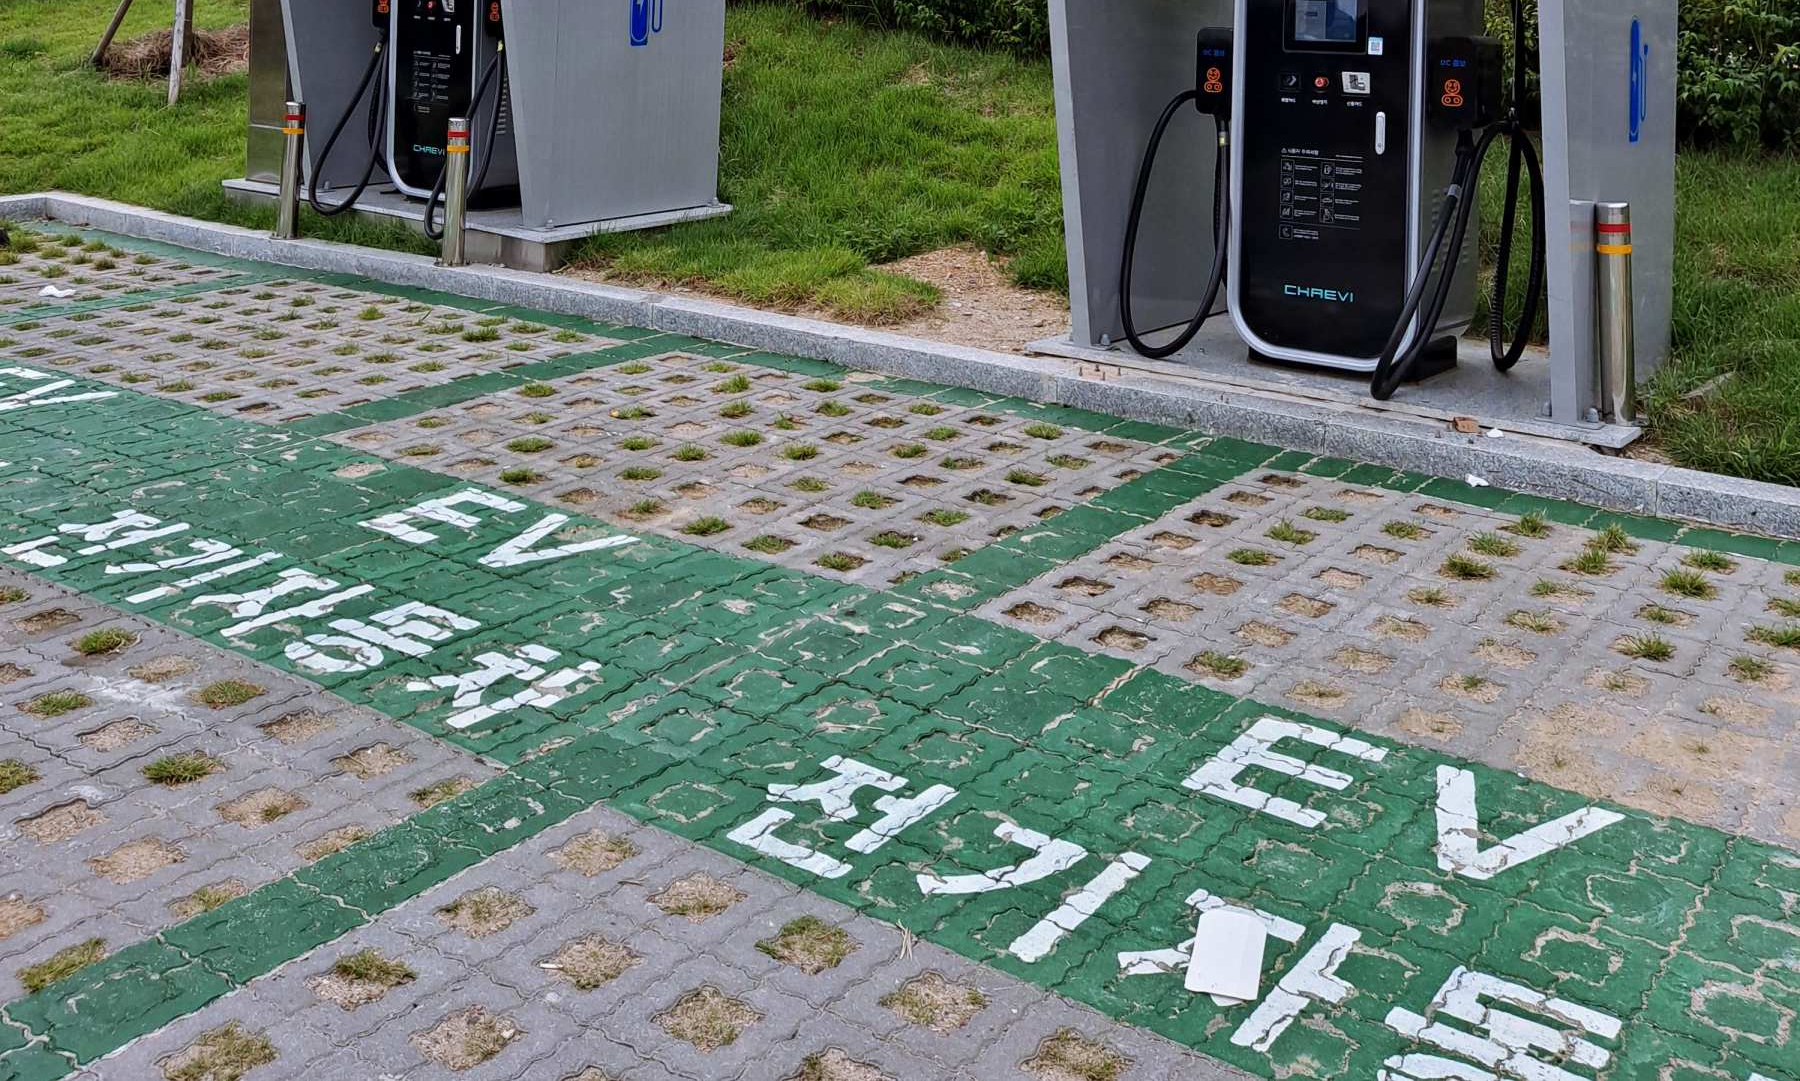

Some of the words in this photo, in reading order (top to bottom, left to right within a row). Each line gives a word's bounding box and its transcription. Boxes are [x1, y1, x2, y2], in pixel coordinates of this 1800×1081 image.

[1284, 284, 1354, 303] CHAEVI
[357, 488, 641, 568] EV
[1, 509, 602, 729] 전기자동차
[1188, 717, 1626, 880] EV
